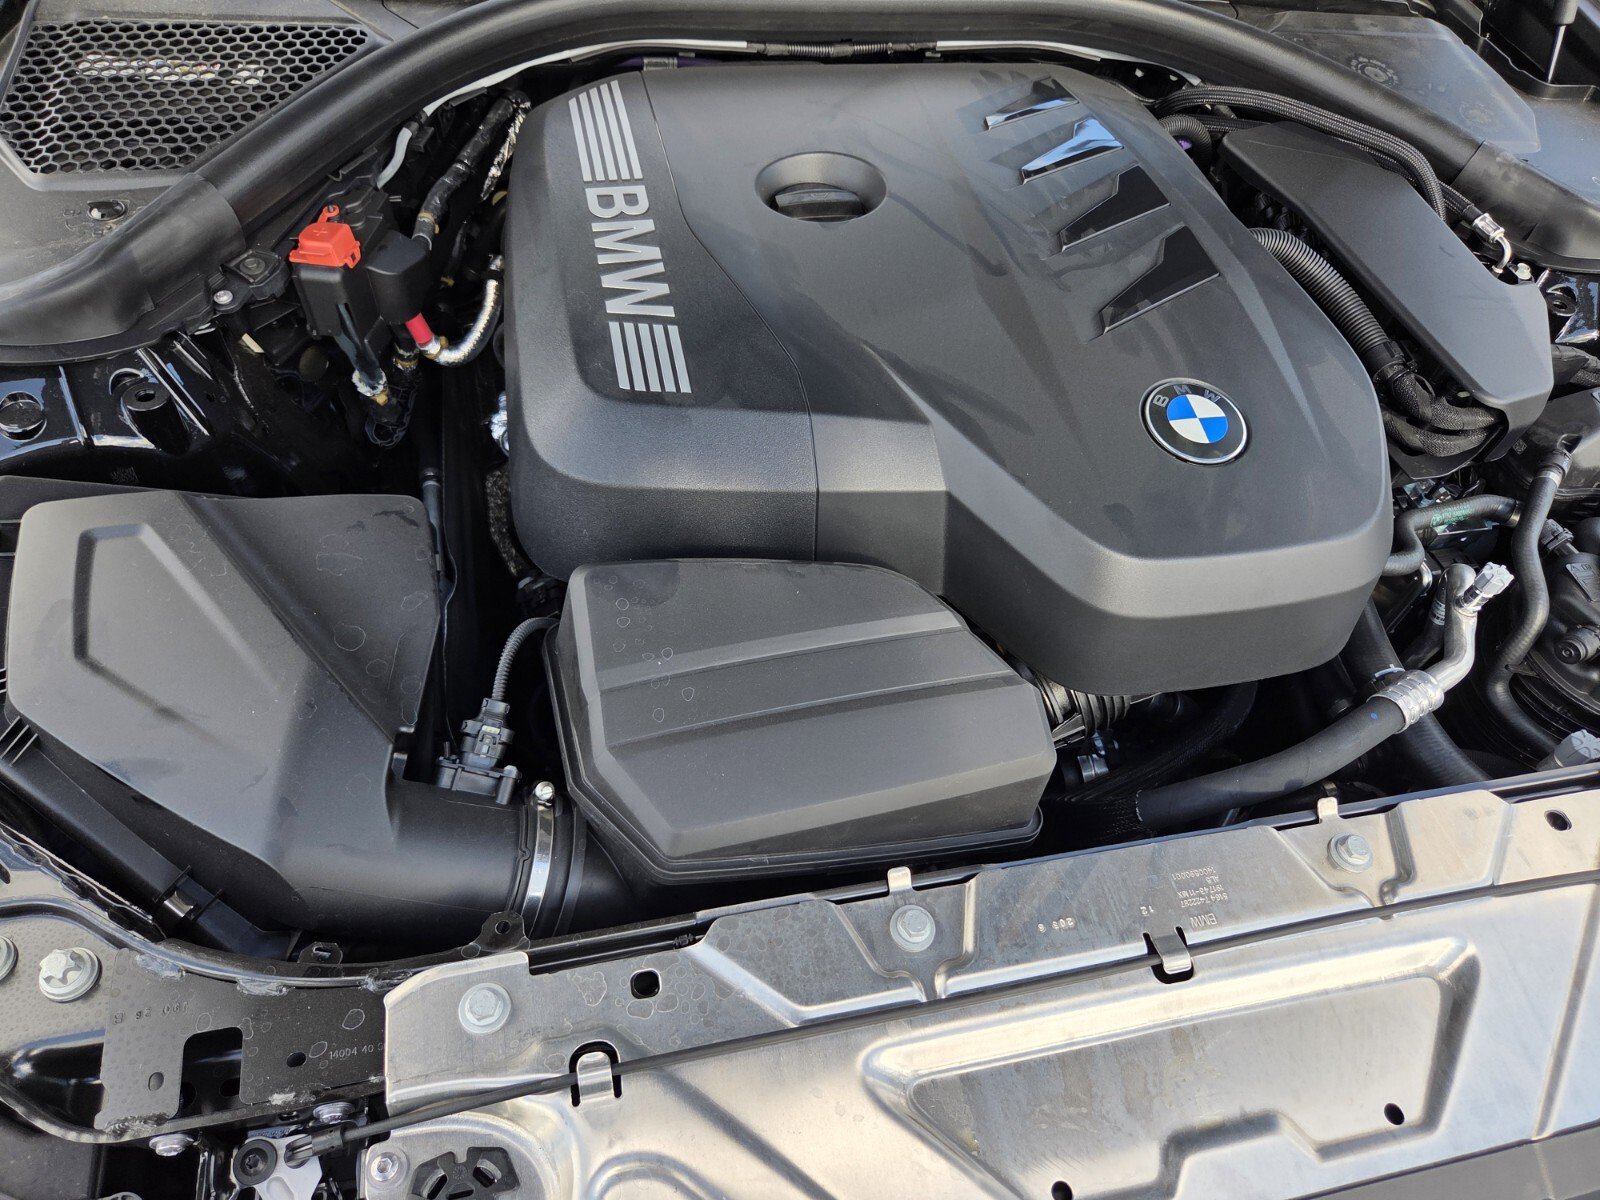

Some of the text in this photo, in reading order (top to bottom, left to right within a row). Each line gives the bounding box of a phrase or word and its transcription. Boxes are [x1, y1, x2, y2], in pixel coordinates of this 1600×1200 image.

[585, 185, 675, 317] BMW
[1152, 385, 1221, 407] BMW
[1190, 913, 1217, 928] BMW
